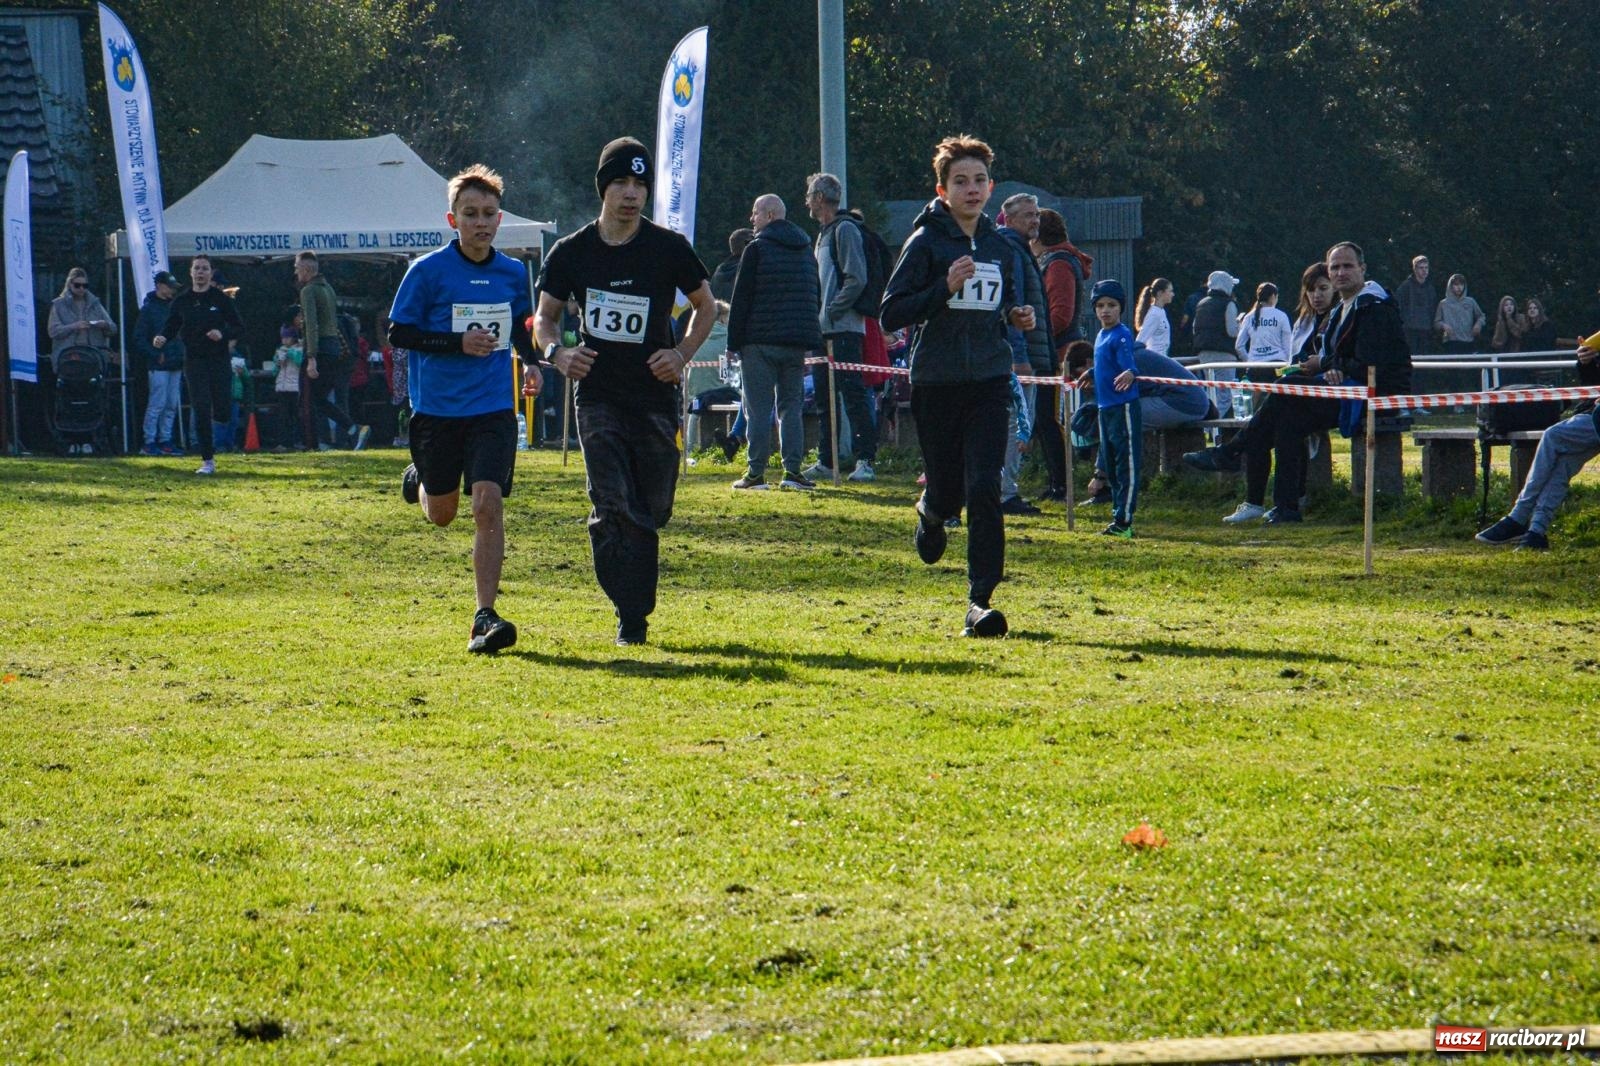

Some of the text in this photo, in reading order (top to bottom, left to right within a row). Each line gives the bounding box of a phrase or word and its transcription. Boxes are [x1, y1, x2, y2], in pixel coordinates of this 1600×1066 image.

[124, 99, 145, 168] STOWARZYSZENIE
[138, 208, 153, 224] DLA
[671, 113, 686, 179] STOWARZYSZENIE
[195, 231, 443, 251] STOWARZYSZENIE AKTYWNI DLA LEPSZEGO
[589, 307, 643, 334] 130
